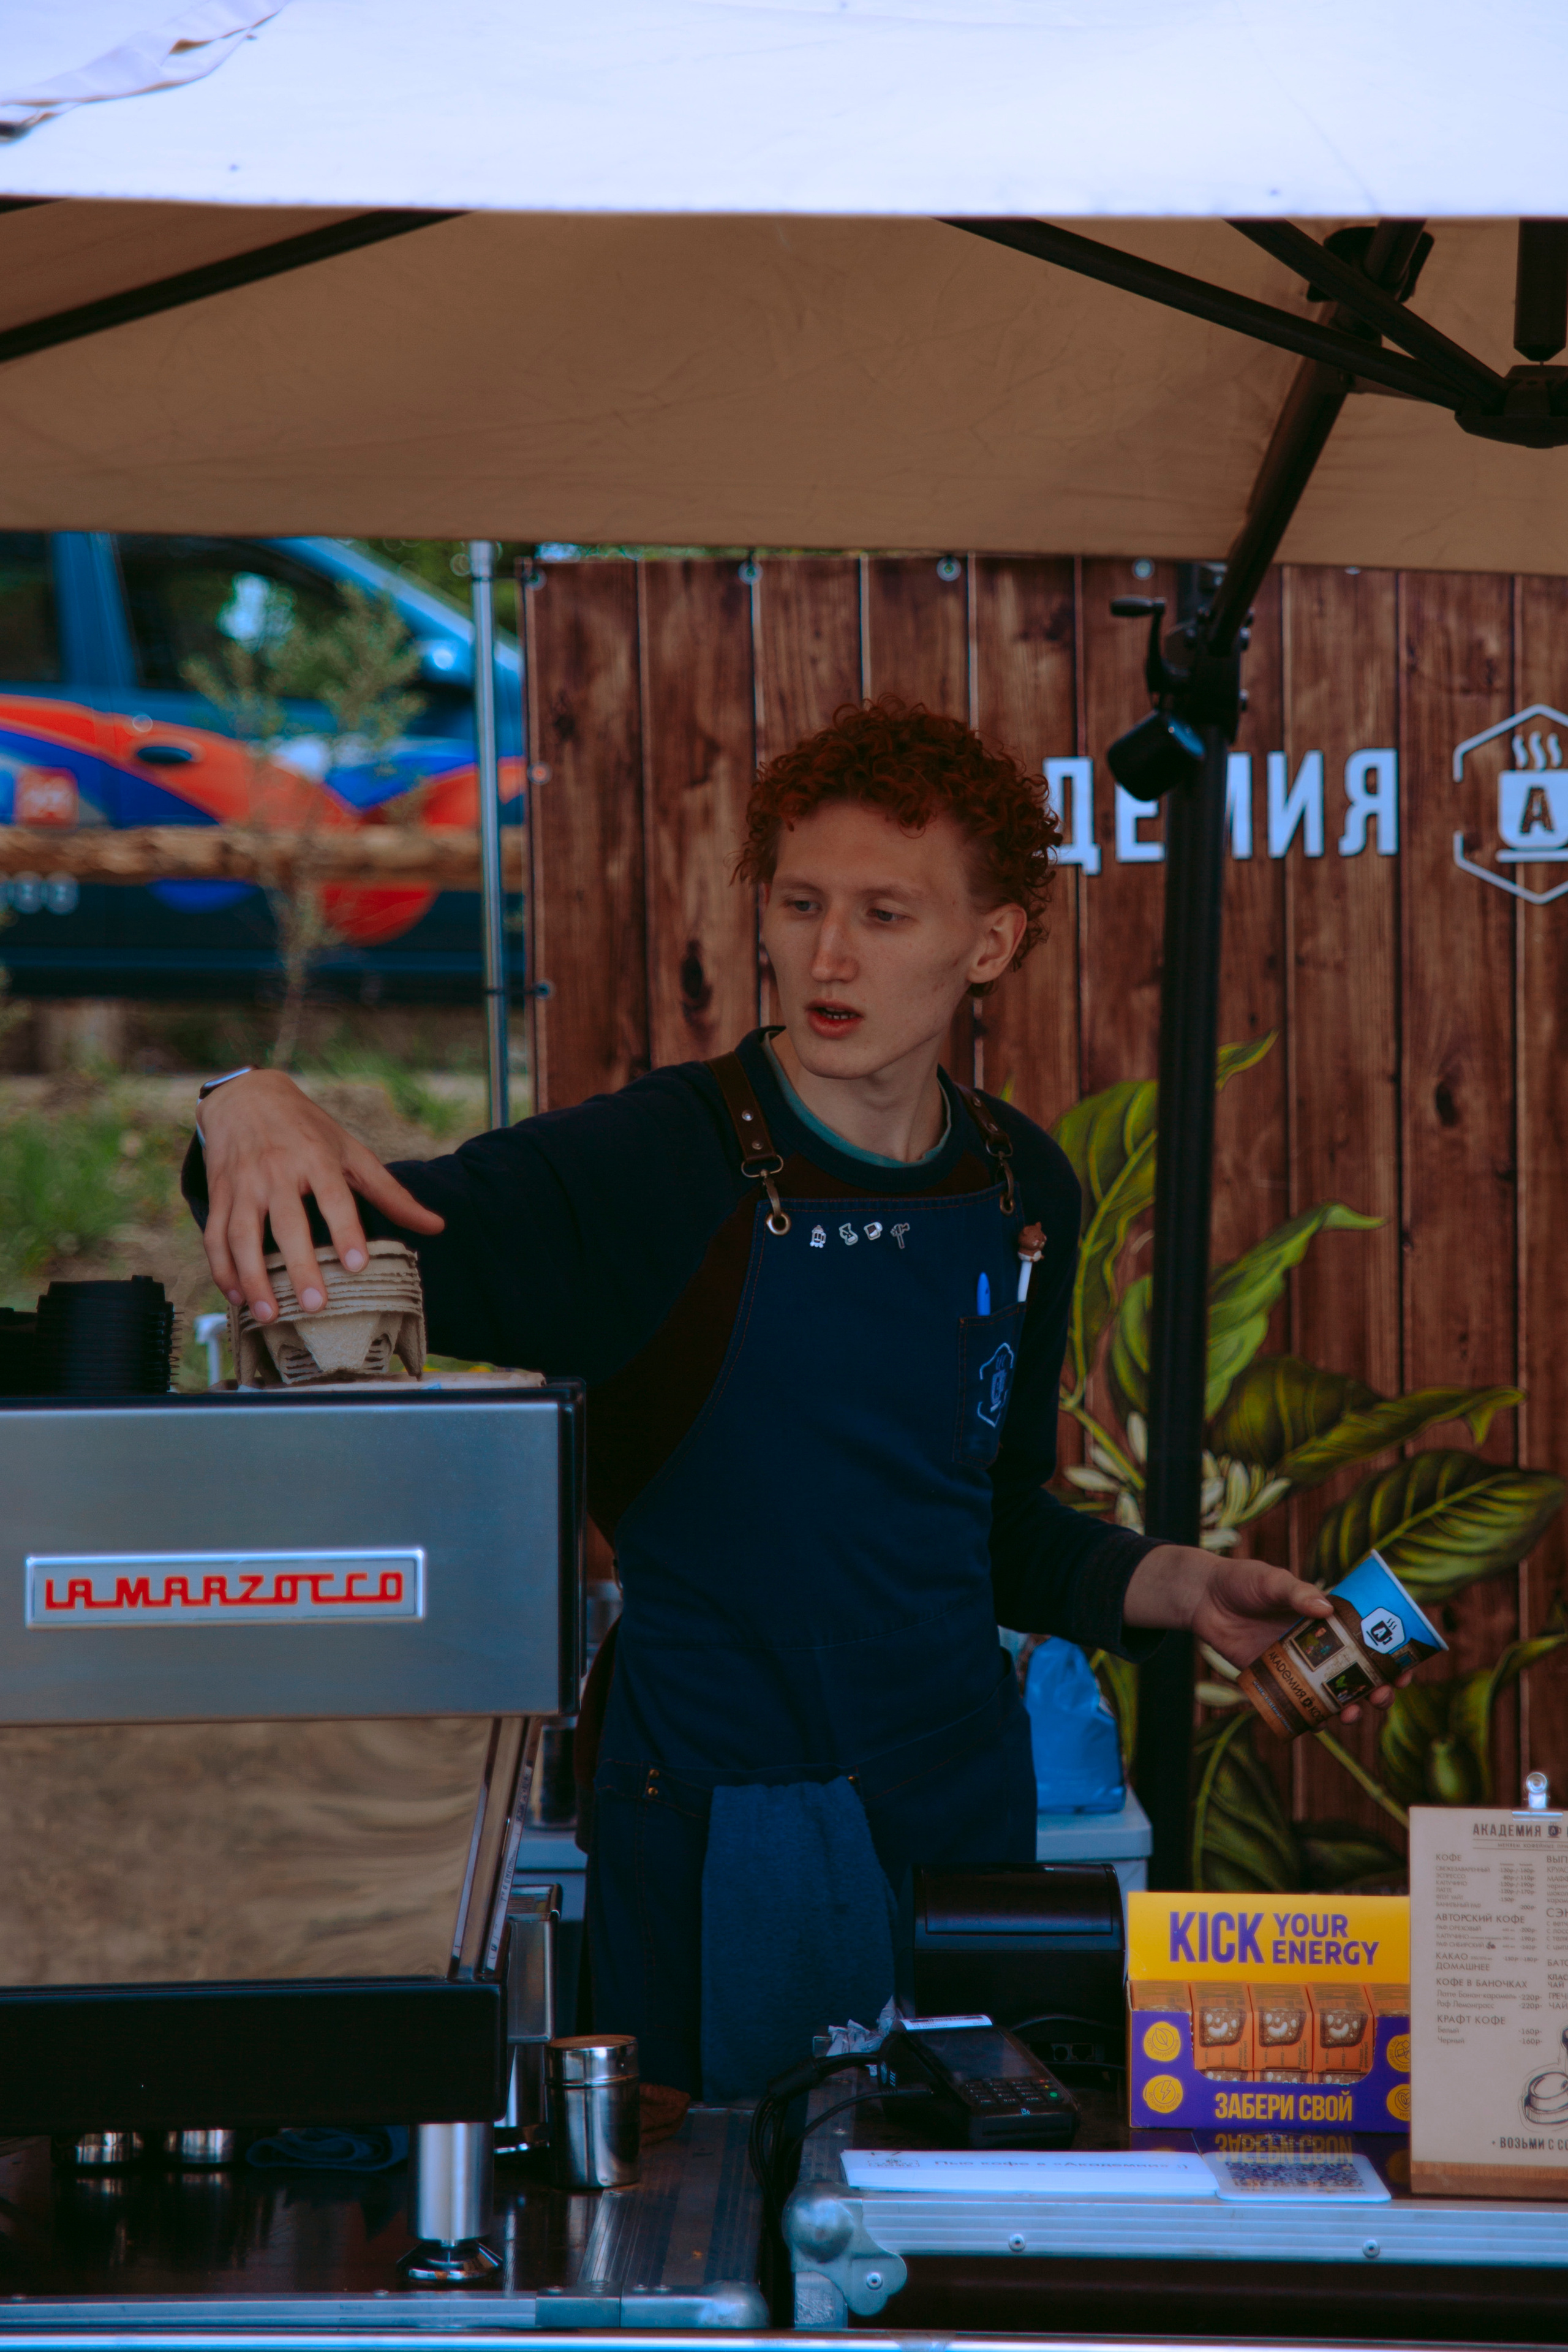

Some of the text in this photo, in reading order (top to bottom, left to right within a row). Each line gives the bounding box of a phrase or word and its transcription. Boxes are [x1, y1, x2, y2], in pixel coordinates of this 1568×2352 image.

[45, 1572, 404, 1610] LA MARZOCCO
[1472, 1823, 1542, 1837] АКАДЕМИЯ
[1436, 1853, 1462, 1862] КОФЕ
[1435, 1913, 1525, 1924] АВТОРСКИЙ КОФЕ
[1169, 1911, 1349, 1964] KICK YOUR
[1272, 1940, 1379, 1966] ENERGY
[1436, 1962, 1490, 1971] ДОМАШНЕЕ
[1436, 1978, 1463, 1986] КОФЕ
[1476, 1979, 1528, 1988] БАНОЧКАХ
[1437, 2014, 1506, 2025] КРАФТ КОФЕ
[1215, 2090, 1352, 2121] ЗАБЕРИ СВОЙ
[1499, 2136, 1545, 2150] ВОЗЬМИ
[1548, 2138, 1554, 2150] С
